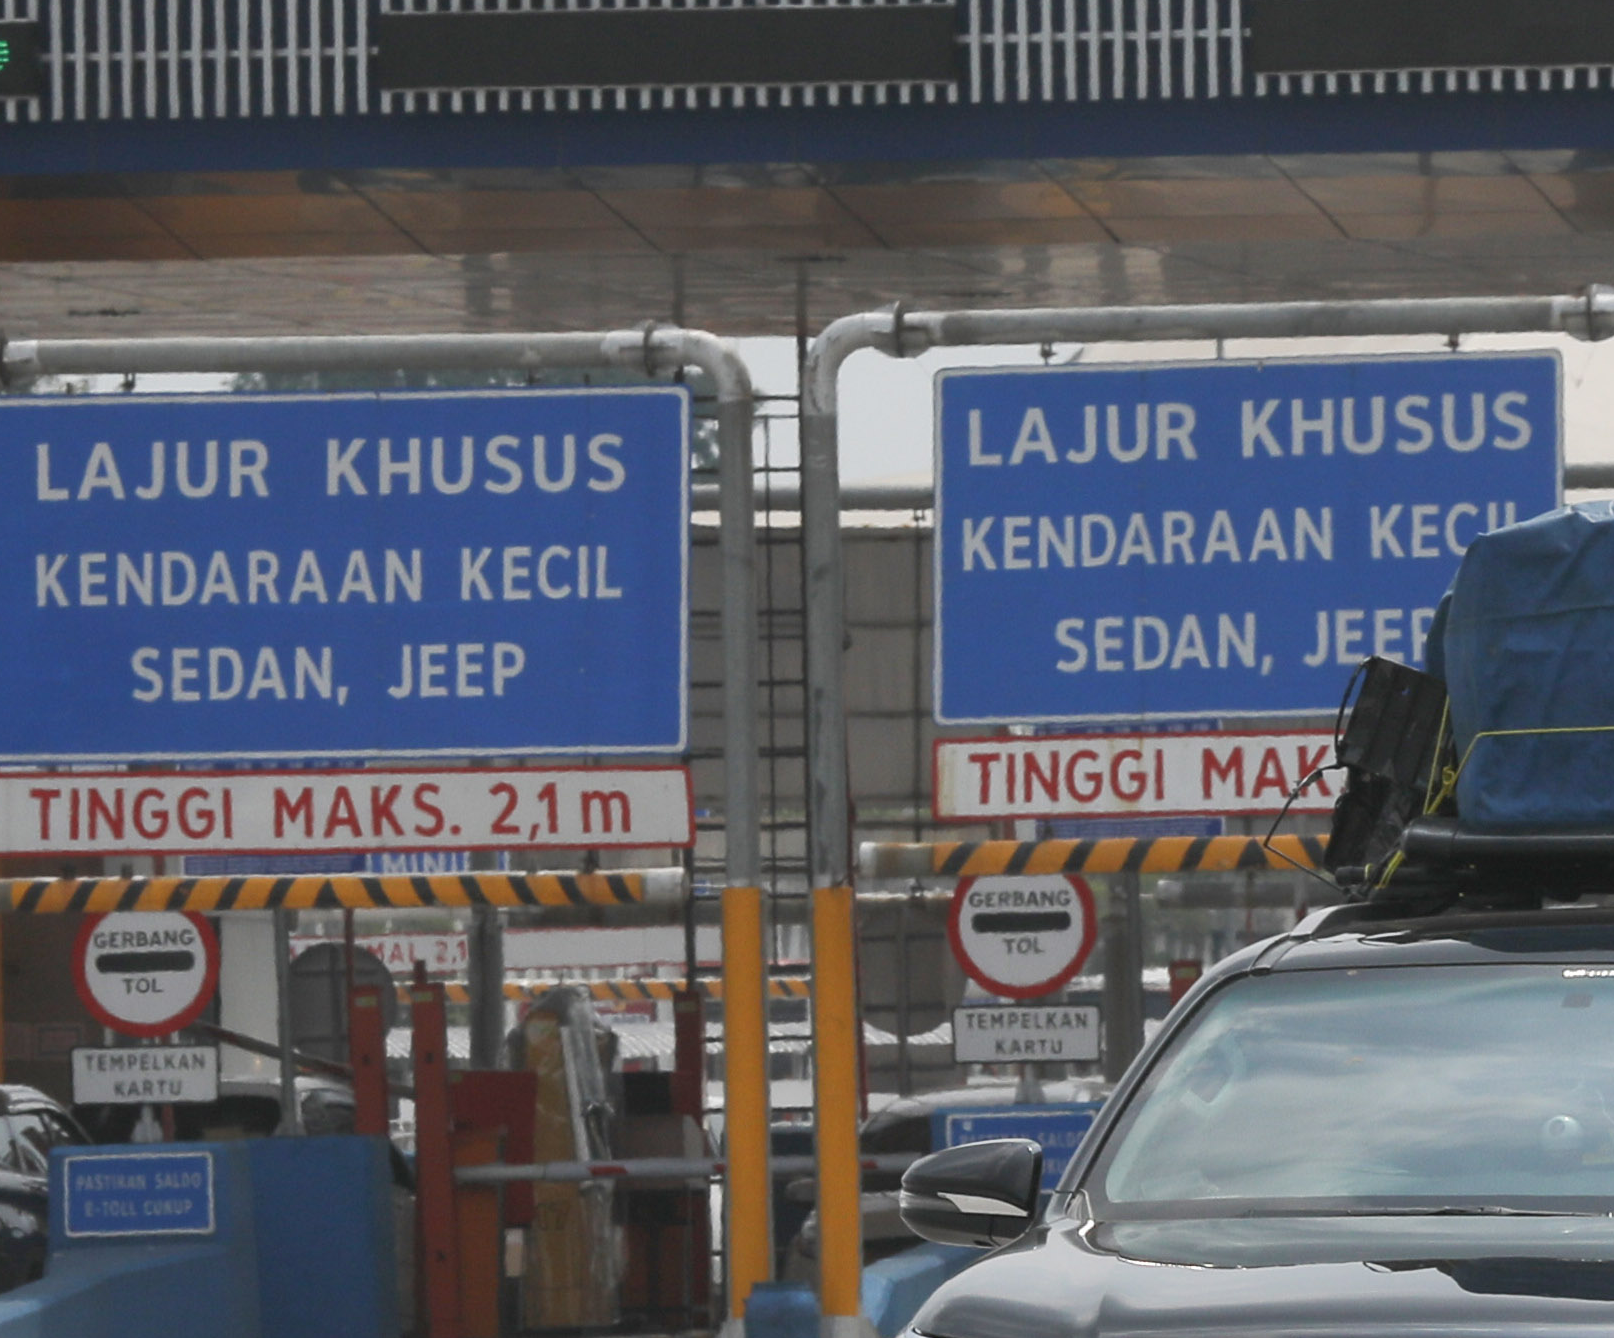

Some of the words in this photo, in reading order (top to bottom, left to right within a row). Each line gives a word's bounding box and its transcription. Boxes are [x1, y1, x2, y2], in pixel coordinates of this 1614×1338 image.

[968, 401, 1198, 467] LAJUR
[1240, 391, 1533, 459] KHUSUS
[36, 439, 271, 502] LAJUR
[326, 433, 626, 497] KHUSUS
[962, 506, 1333, 572] KENDARAAN
[36, 548, 423, 608] KENDARAAN
[462, 544, 622, 601] KECIL
[1055, 612, 1273, 676] SEDAN,
[131, 646, 349, 706] SEDAN,
[387, 642, 526, 699] JEEP
[968, 748, 1165, 804] TINGGI
[1201, 744, 1348, 800] MAK
[30, 787, 233, 841] TINGGI
[274, 782, 462, 839] MAKS.
[968, 889, 1071, 908] GERBANG
[94, 929, 195, 949] GERBANG
[1003, 938, 1045, 955] TOL
[123, 978, 164, 994] TOL
[965, 1013, 1088, 1030] TEMPELKAN
[995, 1039, 1062, 1055] KARTU
[85, 1053, 206, 1073] TEMPELKAN
[114, 1080, 183, 1097] KARTU
[156, 1172, 202, 1188] SALDO
